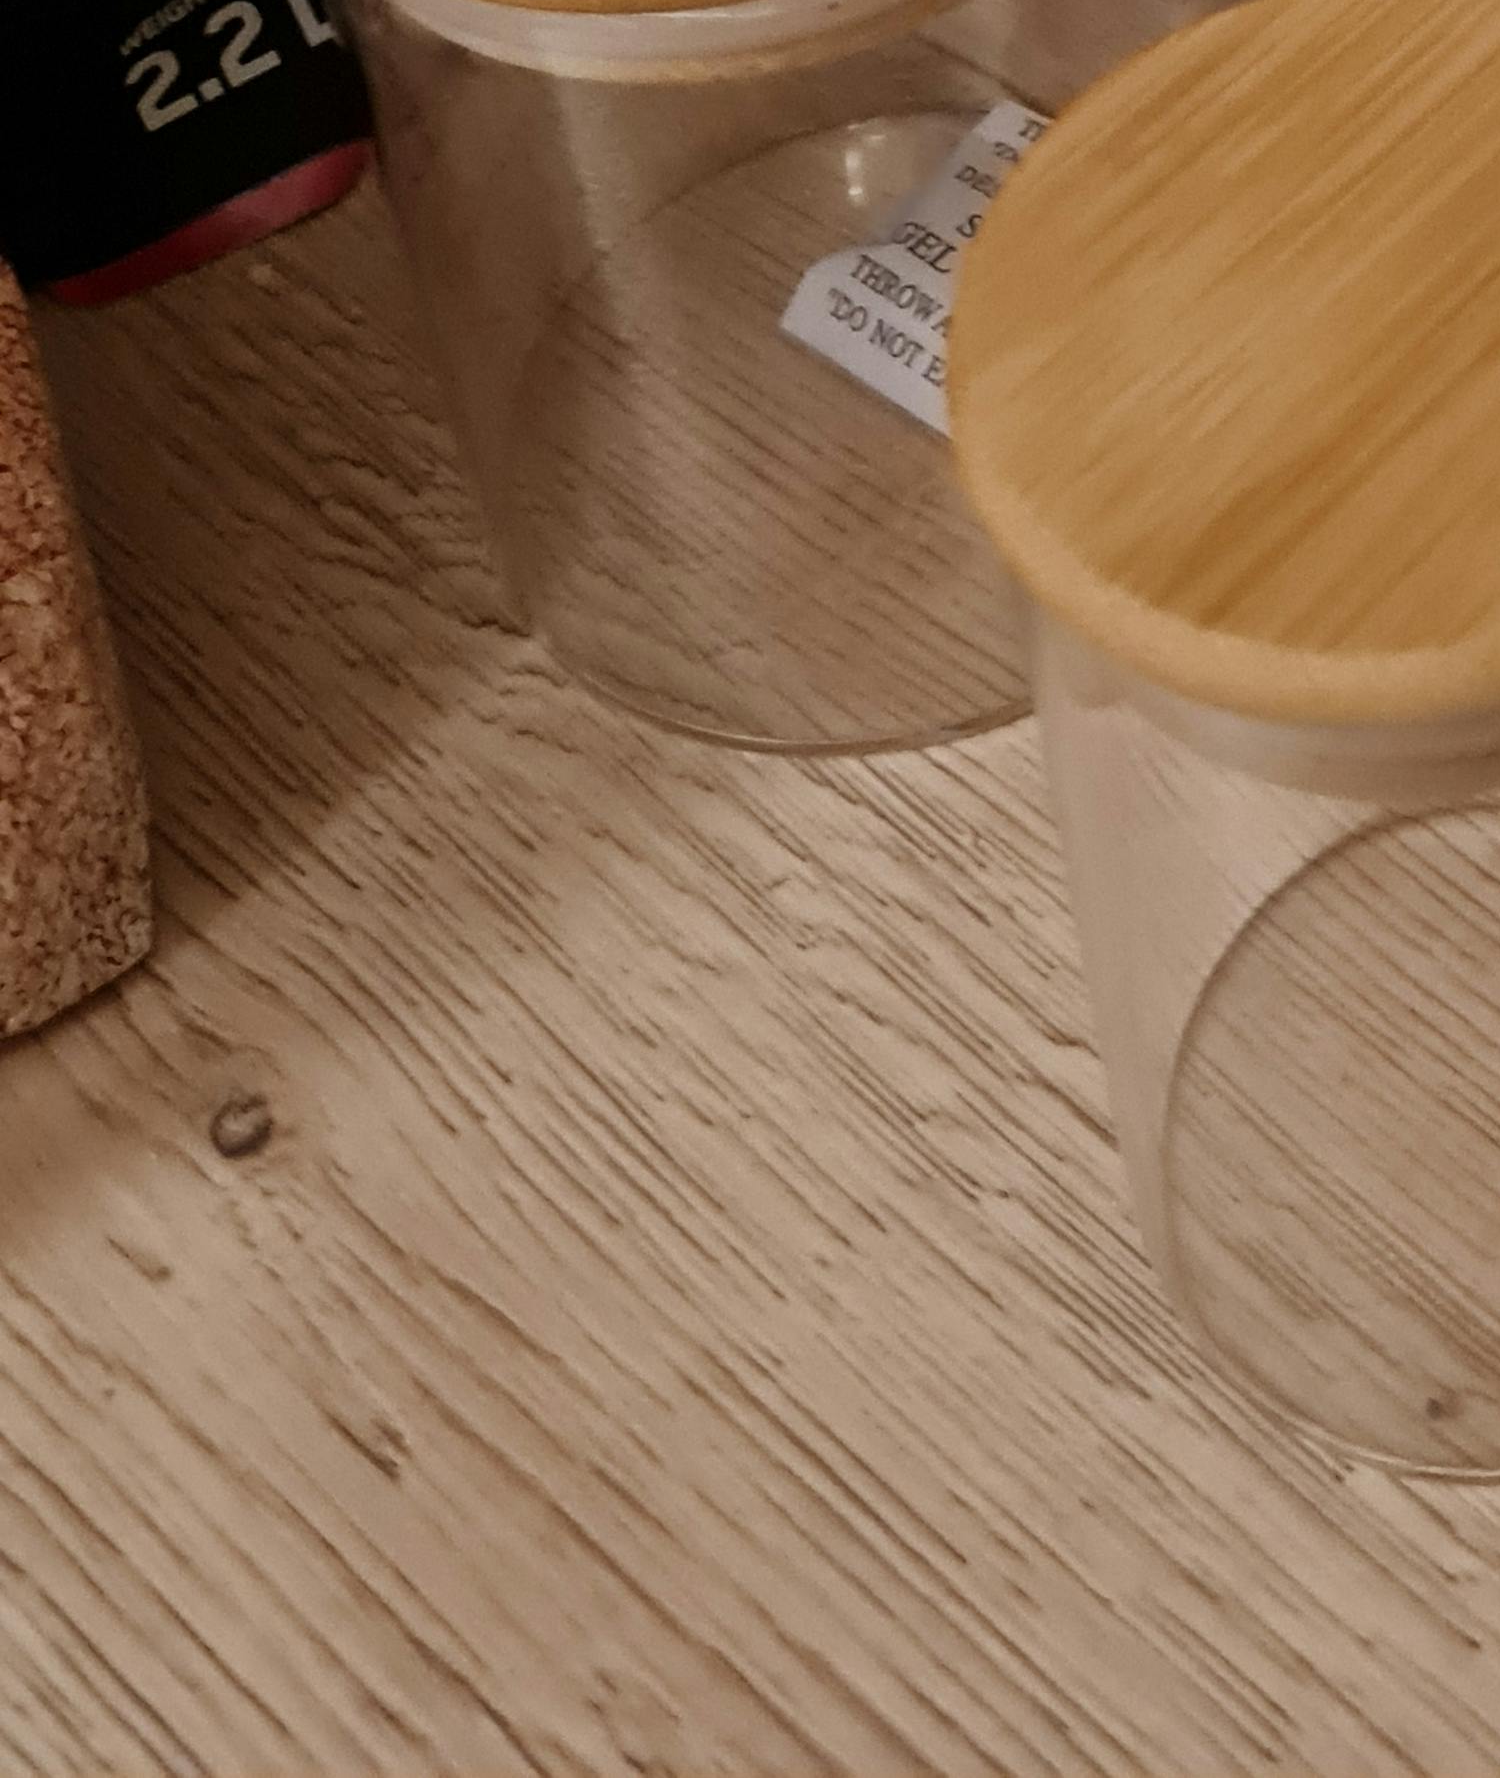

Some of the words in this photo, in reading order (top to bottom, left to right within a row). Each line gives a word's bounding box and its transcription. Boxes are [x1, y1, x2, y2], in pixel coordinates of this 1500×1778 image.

[124, 0, 282, 132] 2.2
[851, 253, 944, 323] THROW
[868, 318, 925, 369] NOT
